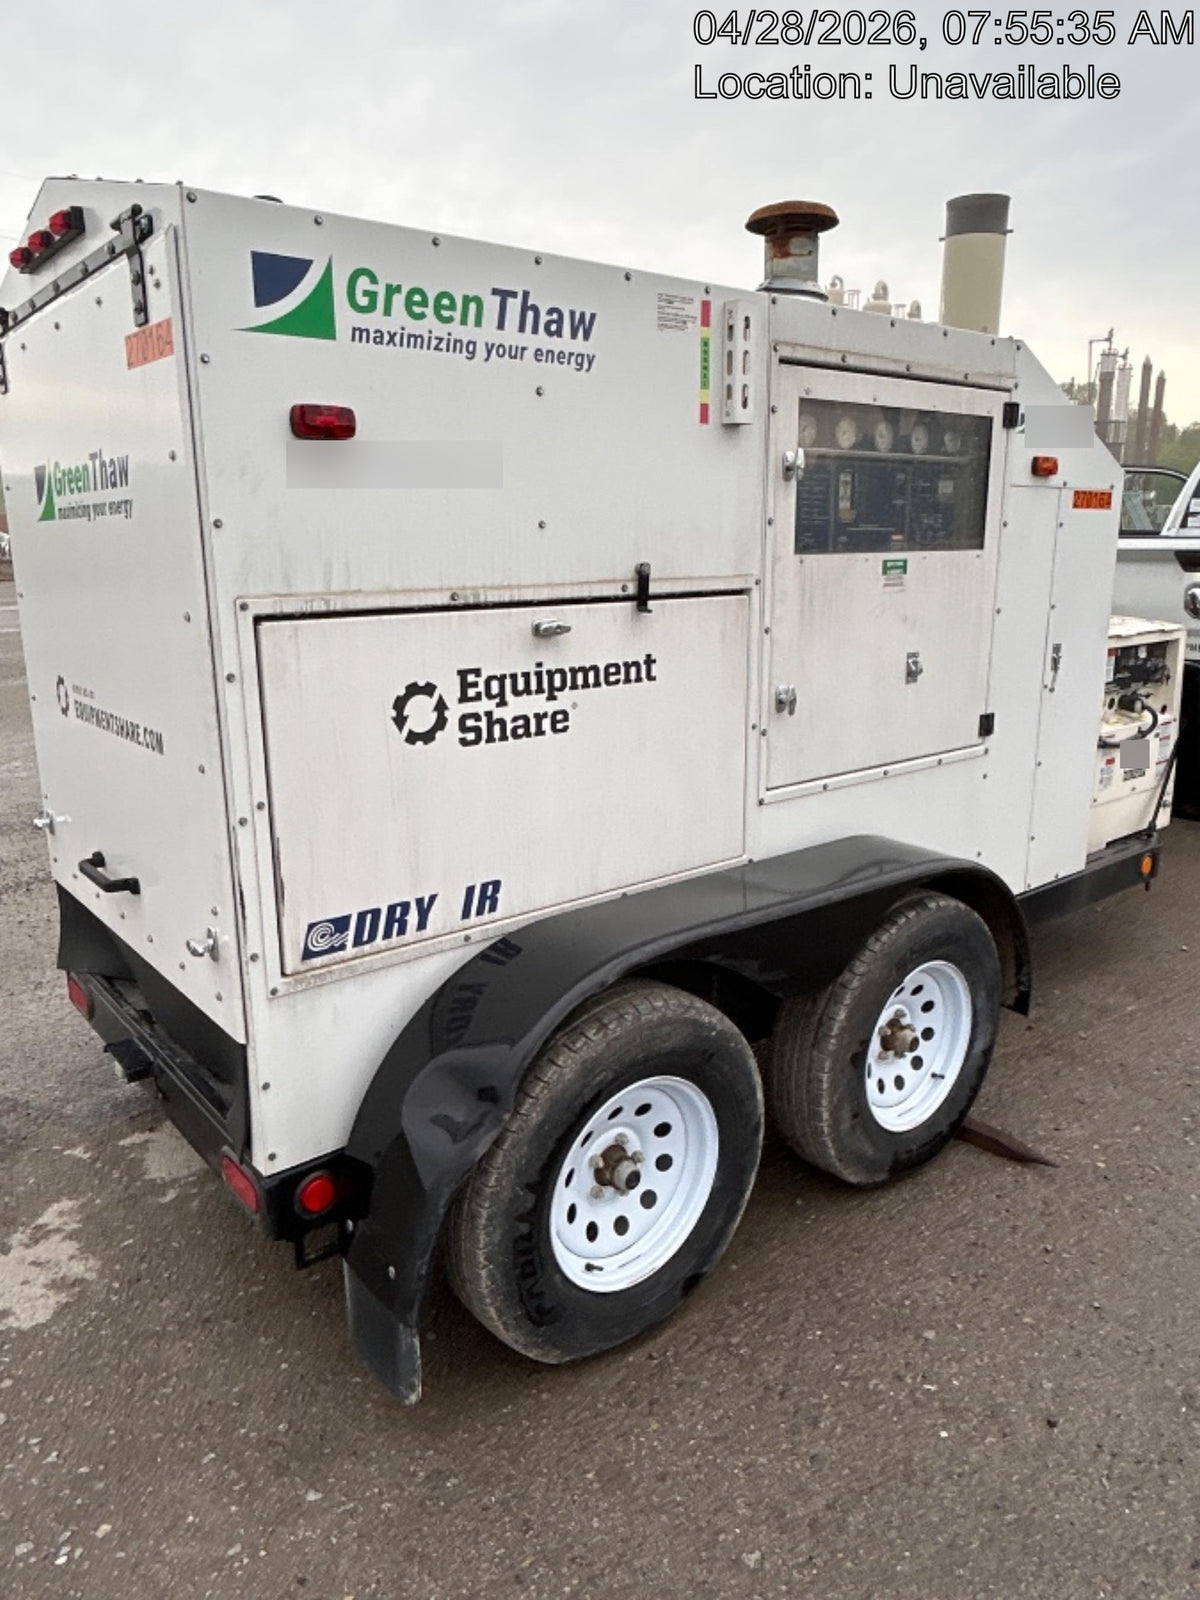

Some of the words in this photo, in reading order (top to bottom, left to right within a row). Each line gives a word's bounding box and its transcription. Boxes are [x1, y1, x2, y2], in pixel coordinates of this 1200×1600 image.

[350, 326, 478, 361] maximizing
[483, 341, 529, 363] your
[533, 347, 597, 373] energy
[456, 653, 658, 708] Equipment
[458, 708, 570, 748] Share
[352, 892, 439, 949] DRY
[461, 879, 502, 921] IR
